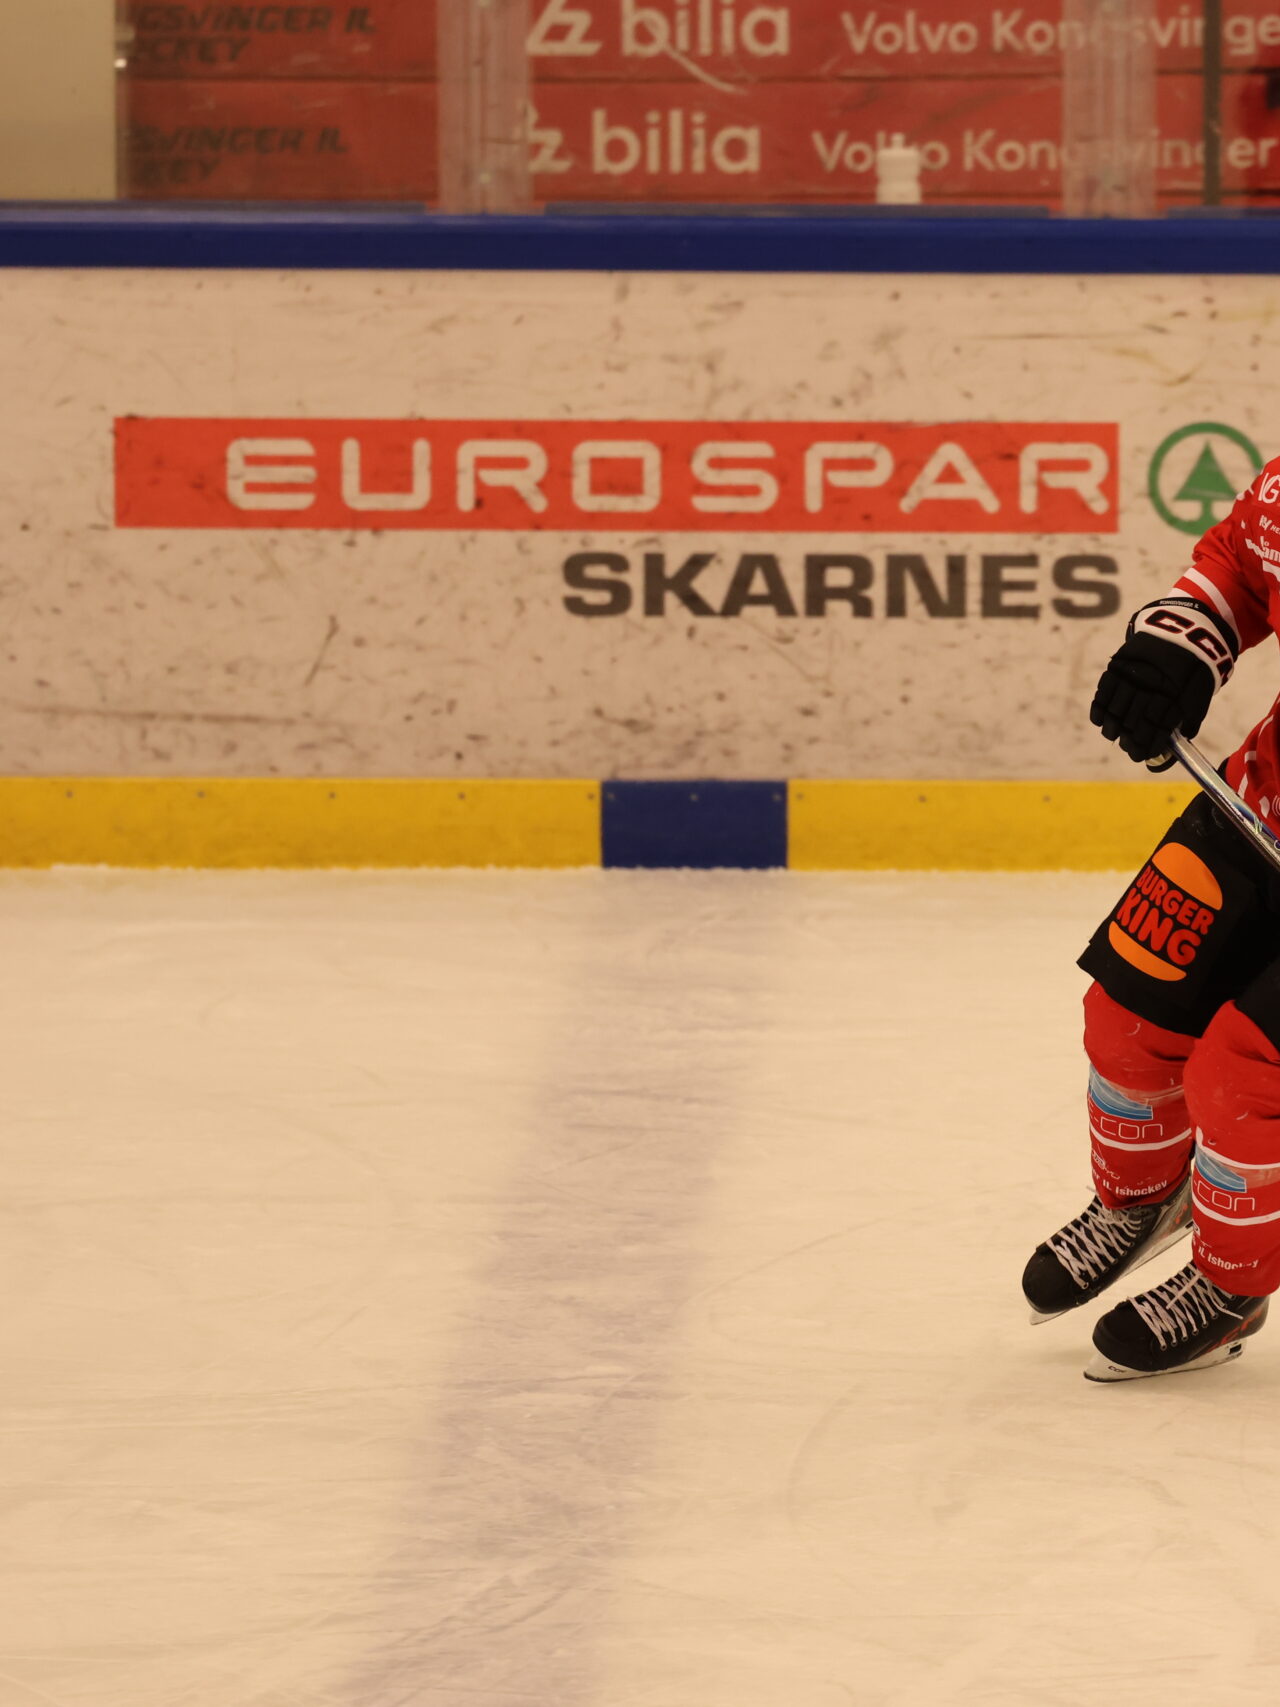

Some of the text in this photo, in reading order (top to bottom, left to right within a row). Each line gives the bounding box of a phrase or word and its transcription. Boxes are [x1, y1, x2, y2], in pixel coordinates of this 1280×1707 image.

[621, 0, 790, 56] bilia
[840, 11, 978, 55] Volvo
[592, 108, 761, 174] bilia
[226, 437, 1110, 513] EUROSPAR
[562, 551, 1121, 619] SKARNES
[1116, 887, 1202, 966] KING
[1135, 864, 1215, 935] BURGER
